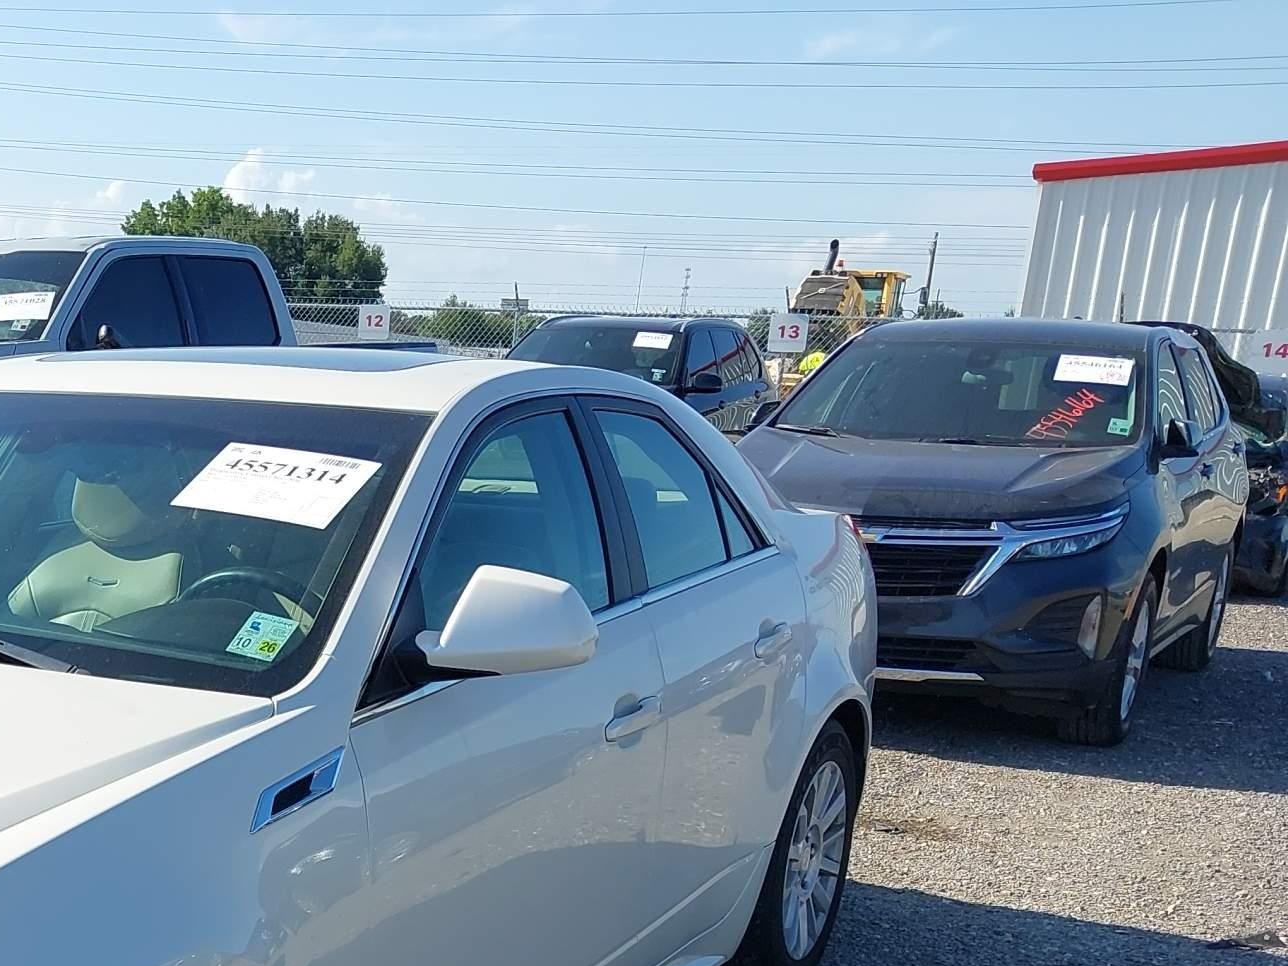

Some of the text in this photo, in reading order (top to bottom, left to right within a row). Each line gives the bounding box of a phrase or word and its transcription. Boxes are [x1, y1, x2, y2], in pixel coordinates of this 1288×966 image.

[365, 314, 384, 328] 12
[777, 324, 801, 339] 13
[1263, 342, 1288, 359] 14
[225, 458, 349, 485] 45571314
[235, 636, 278, 653] 10 26
